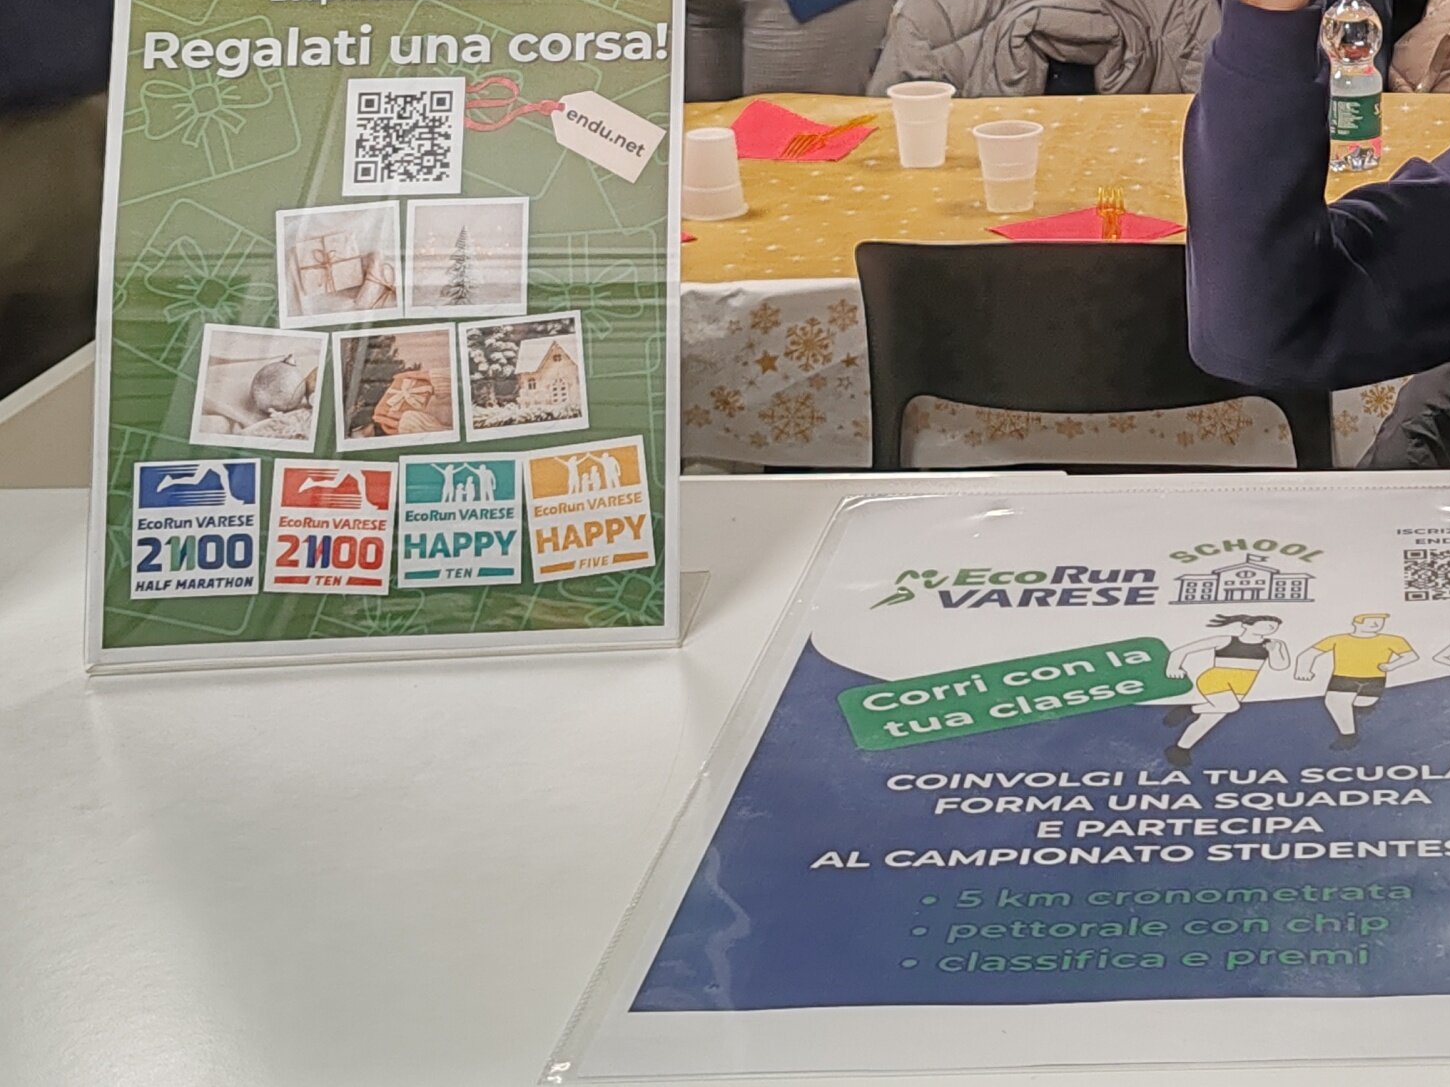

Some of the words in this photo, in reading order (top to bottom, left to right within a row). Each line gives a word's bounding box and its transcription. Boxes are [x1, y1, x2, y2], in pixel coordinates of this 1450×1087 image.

[144, 25, 372, 78] Regalati
[390, 33, 491, 66] una
[508, 23, 668, 62] corsa!
[565, 106, 646, 158] endu.net
[405, 509, 456, 522] EcoRun
[459, 506, 515, 521] VARESE
[533, 502, 585, 518] EcoRun
[588, 491, 642, 511] VARESE
[137, 516, 192, 530] EcoRun
[195, 514, 254, 529] VARESE
[279, 516, 330, 530] EcoRun
[332, 516, 387, 531] VARESE
[536, 513, 646, 554] HAPPY
[403, 530, 517, 559] HAPPY
[1169, 538, 1325, 564] SCHOOL
[445, 567, 473, 579] TEN
[578, 555, 610, 569] FIVE
[135, 579, 172, 592] HALF
[175, 576, 253, 590] MARATHON
[314, 575, 342, 586] TEN
[951, 565, 1158, 587] EcoRun
[937, 586, 1160, 609] VARESE
[862, 673, 989, 711] Corri
[1002, 660, 1096, 687] con
[1105, 648, 1153, 668] la
[883, 711, 974, 738] tua
[988, 678, 1146, 719] classe
[886, 770, 1125, 791] COINVOLGI
[1137, 770, 1192, 786] LA
[1203, 769, 1288, 785] TUA
[934, 794, 1094, 815] FORMA
[1107, 793, 1202, 812] UNA
[1214, 788, 1433, 811] SQUADRA
[1036, 820, 1063, 838] E
[1076, 816, 1324, 838] PARTECIPA
[810, 850, 870, 869] AL
[884, 844, 1194, 868] CAMPIONATO
[956, 890, 982, 908] 5
[998, 888, 1071, 908] km
[1087, 882, 1414, 906] cronometrata
[946, 917, 1168, 943] pettorale
[1184, 915, 1269, 935] con
[1286, 912, 1389, 937] chip
[937, 948, 1165, 973] classifica
[1181, 950, 1210, 968] e
[1225, 942, 1370, 970] premi
